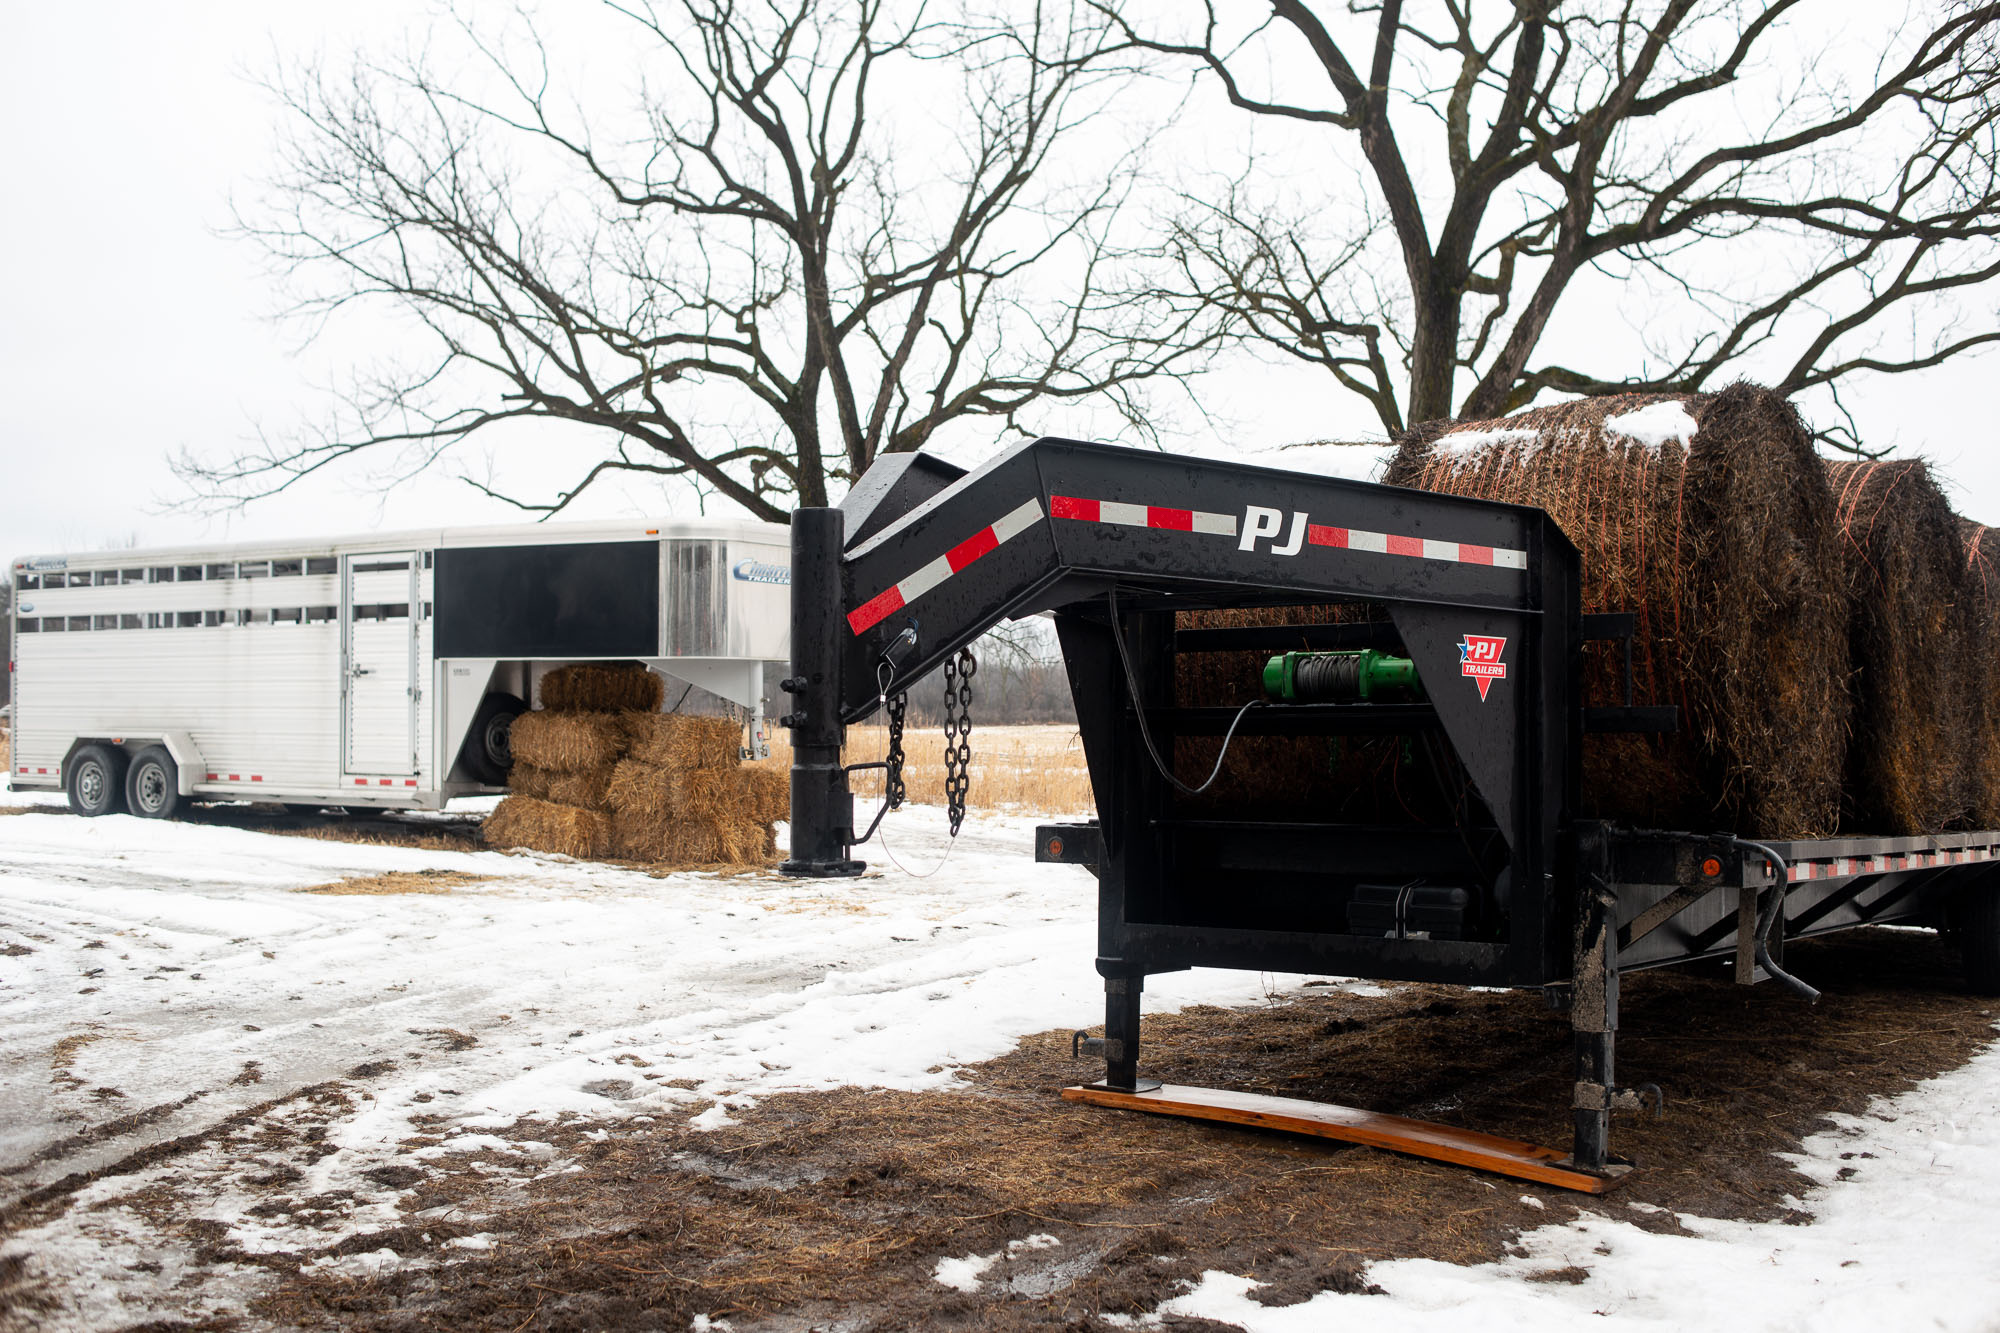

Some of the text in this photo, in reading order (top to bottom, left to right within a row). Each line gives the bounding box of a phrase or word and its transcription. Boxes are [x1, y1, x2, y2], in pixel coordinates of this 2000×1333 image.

[1238, 505, 1309, 556] PJ
[747, 576, 791, 585] TRAILER
[1474, 642, 1496, 659] PJ
[1465, 664, 1504, 675] TRAILERS
